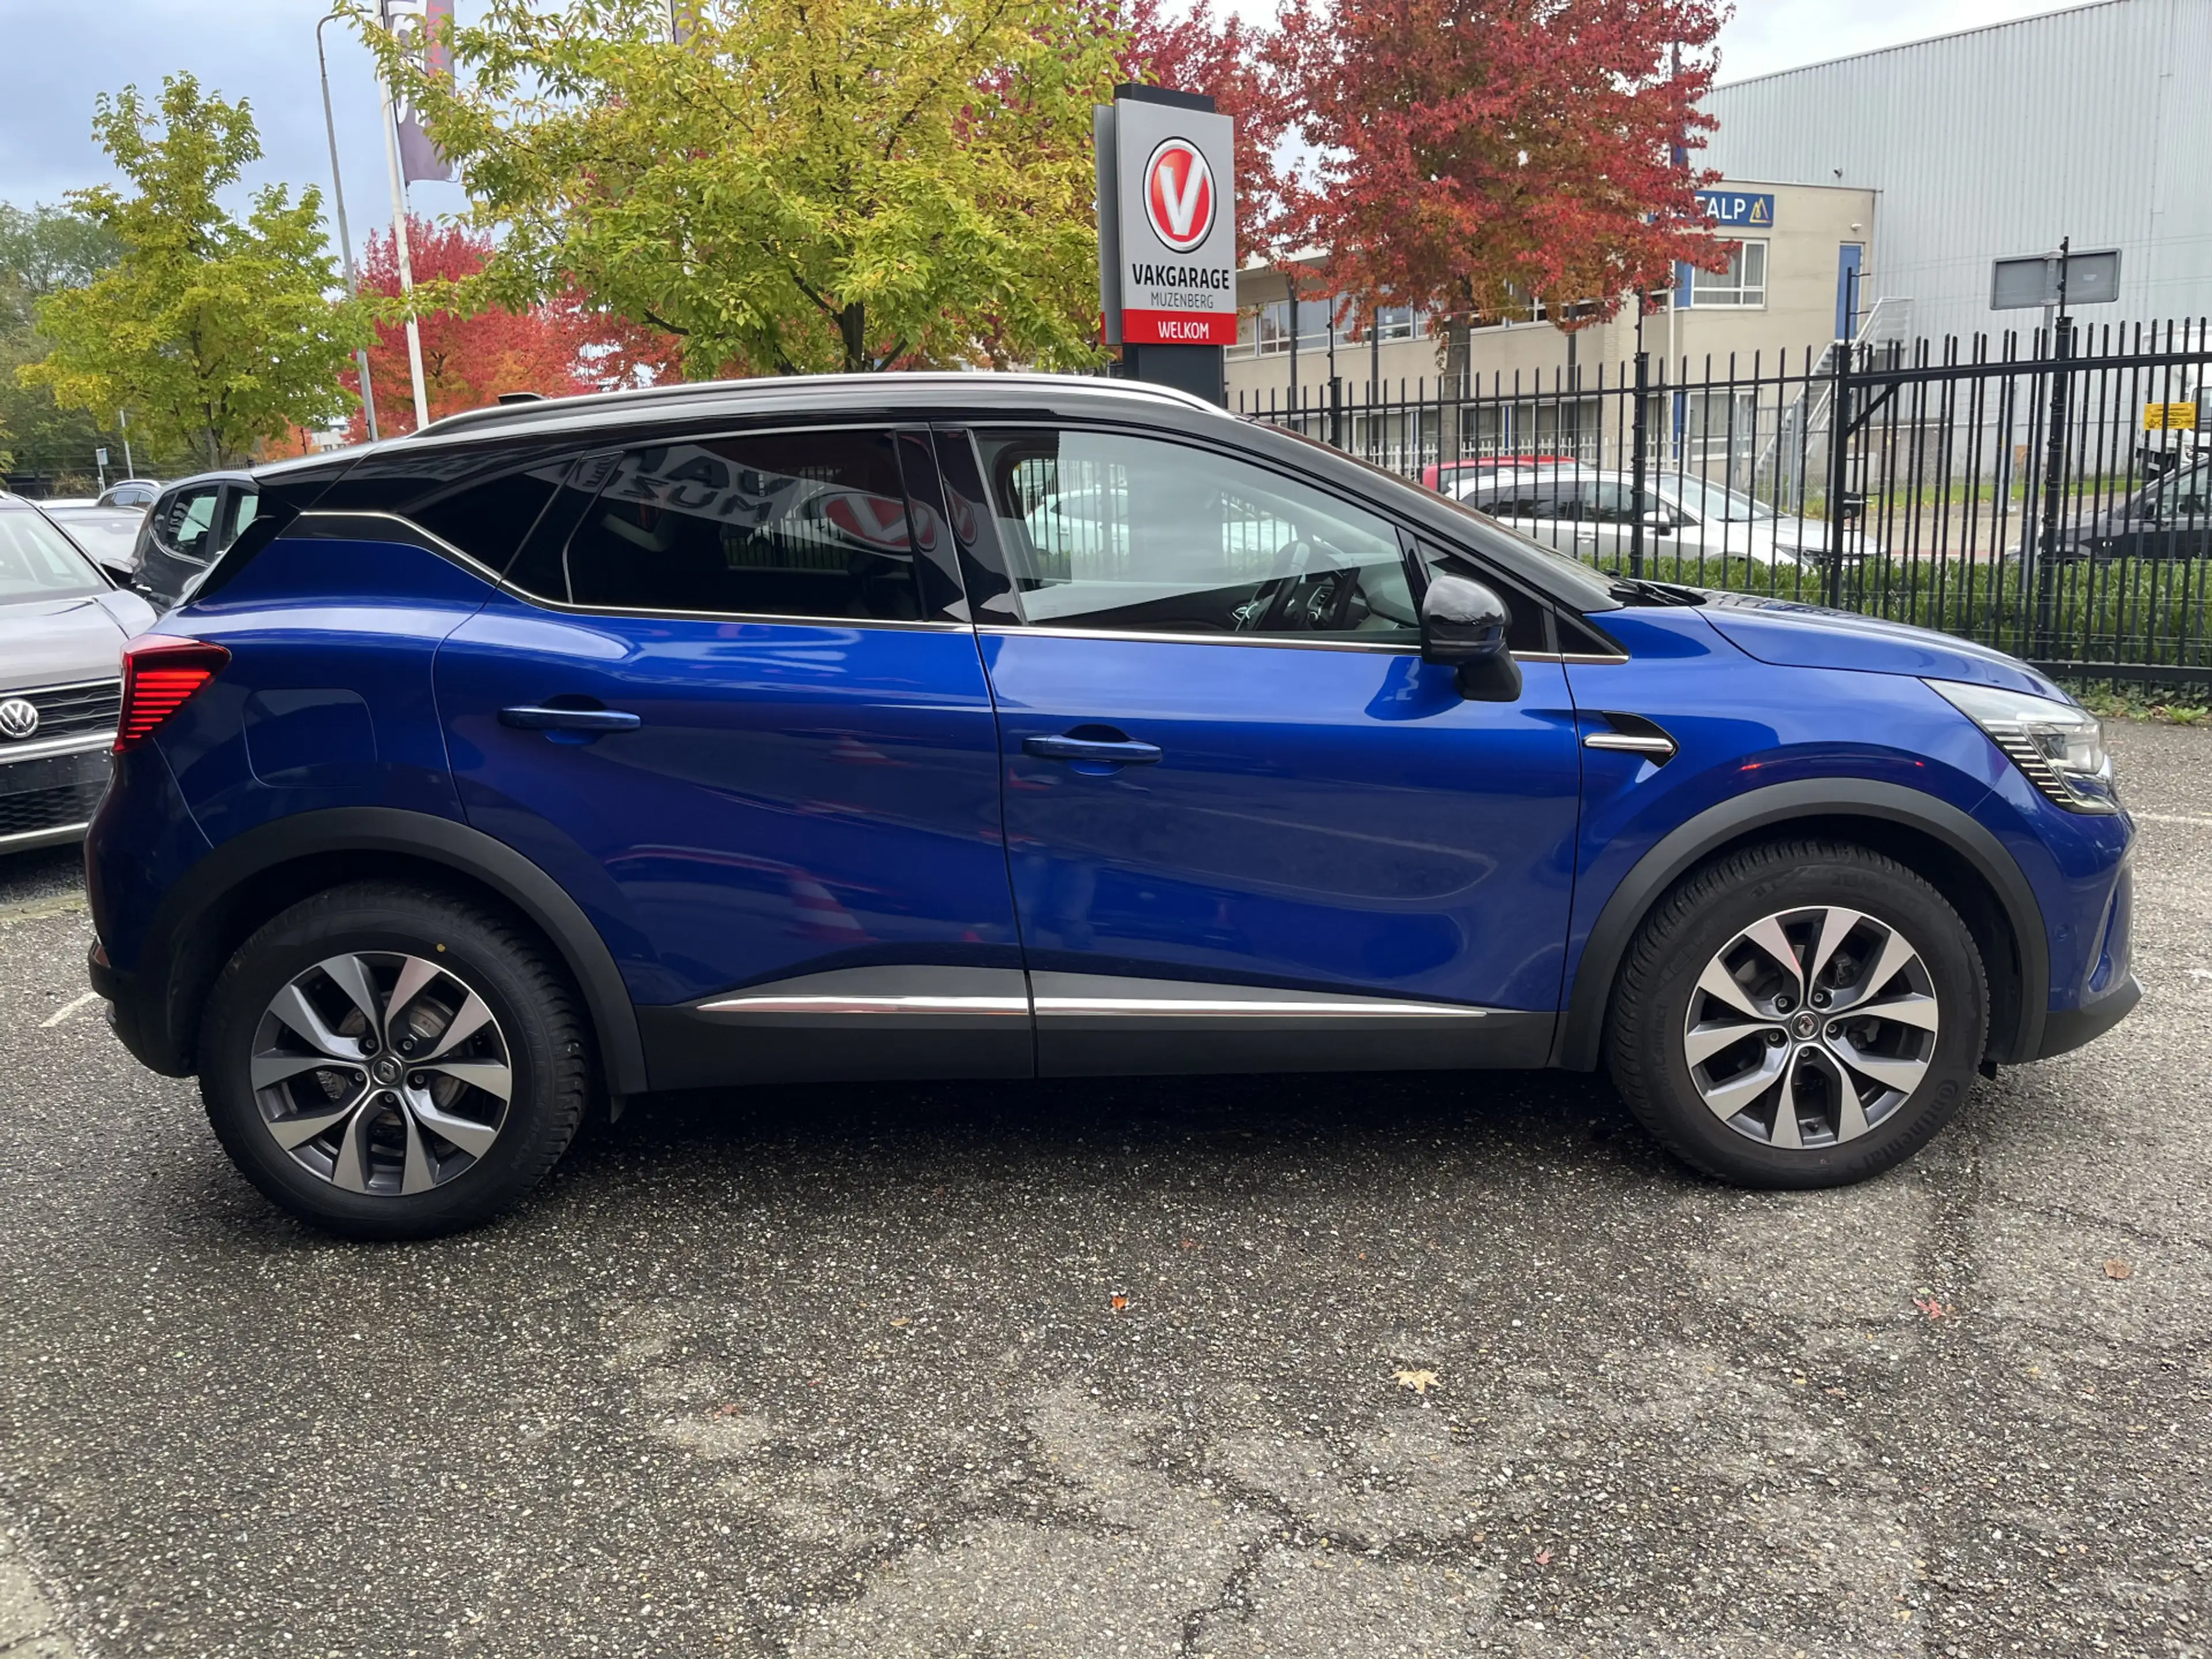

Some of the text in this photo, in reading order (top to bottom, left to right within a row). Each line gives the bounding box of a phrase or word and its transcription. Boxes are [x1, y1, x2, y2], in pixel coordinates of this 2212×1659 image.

[1132, 263, 1230, 290] VAKGARAGE
[1150, 291, 1214, 309] MUZENBERG
[1157, 321, 1210, 339] WELKOM
[1862, 1078, 1959, 1168] Continental
